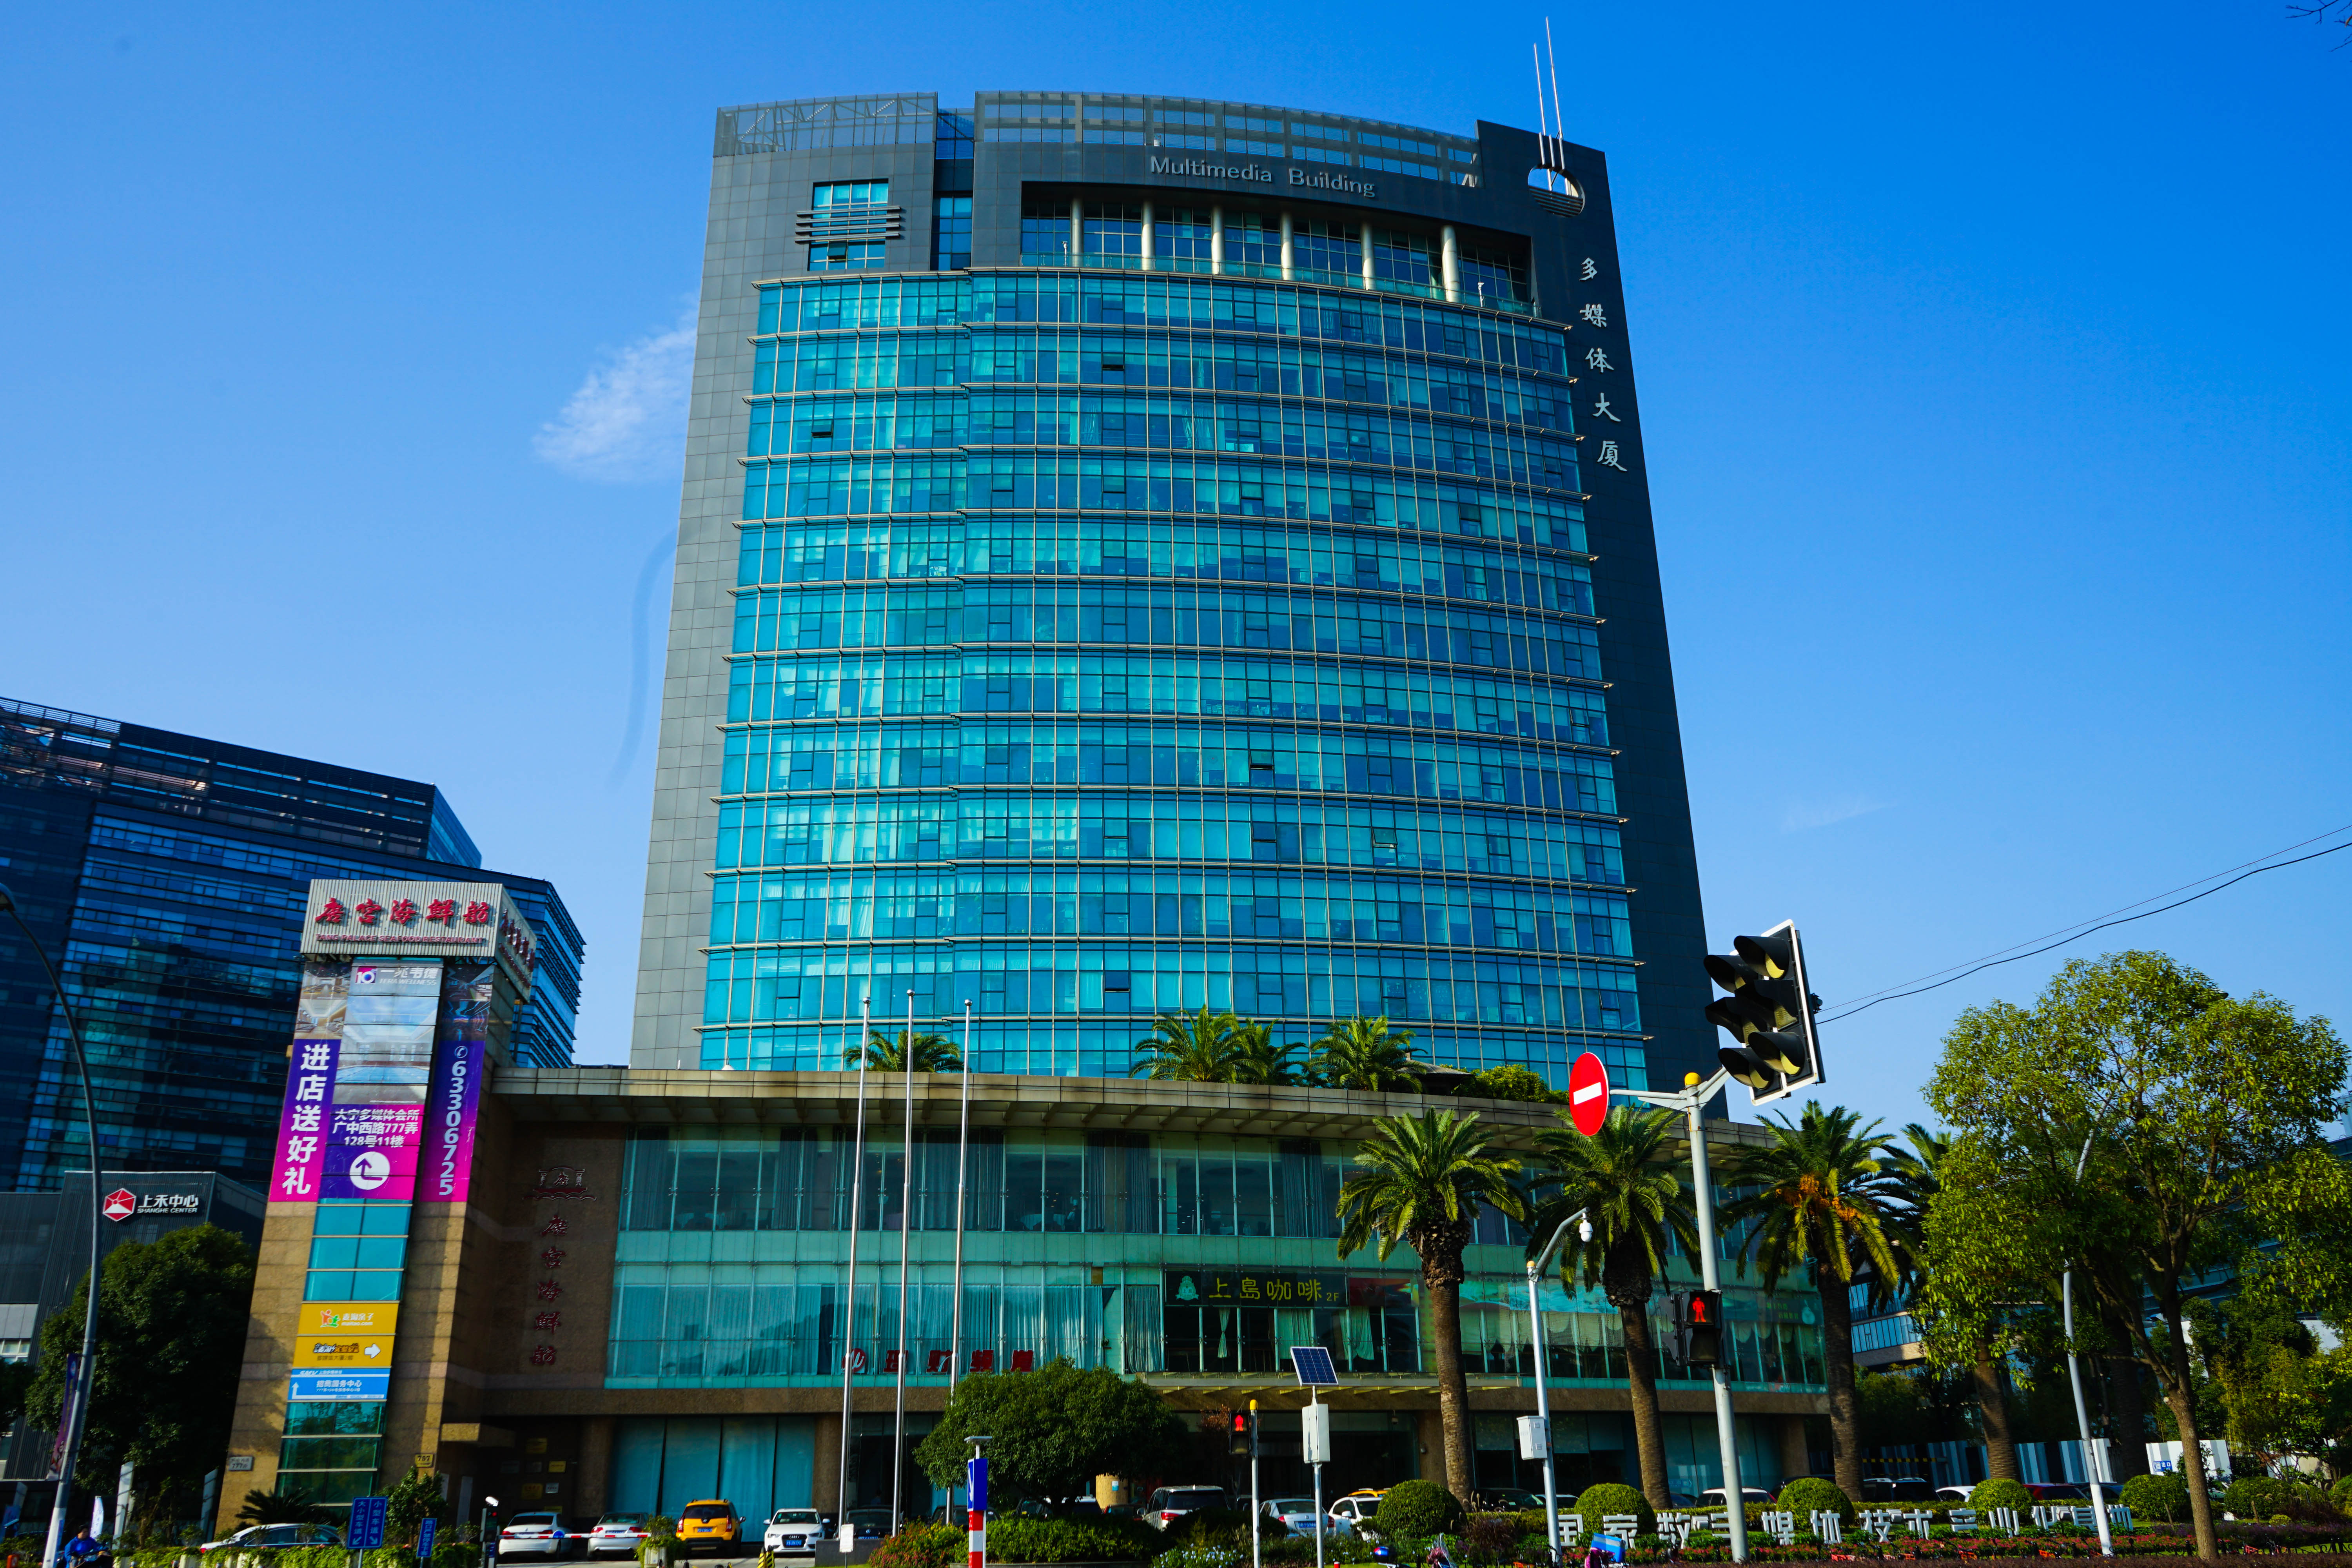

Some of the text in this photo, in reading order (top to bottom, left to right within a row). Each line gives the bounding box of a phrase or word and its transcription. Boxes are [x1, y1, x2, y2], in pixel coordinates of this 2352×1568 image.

[1151, 156, 1375, 198] Multimedia Building
[1579, 257, 1628, 472] 多媒体大厦
[380, 967, 439, 979] 一兆韦德
[282, 1044, 330, 1195] 进店送好礼
[334, 1108, 420, 1121] 大宁多媒体会所
[332, 1121, 419, 1134] 广中西路777弄
[439, 1061, 466, 1196] 63306725
[344, 1135, 405, 1148] 128号11楼
[138, 1194, 199, 1208] 上禾中心
[1327, 1292, 1339, 1302] 2F
[316, 1379, 362, 1388] 招商服务中心
[353, 1500, 367, 1534] 大小型车道
[370, 1500, 383, 1534] 小型车道
